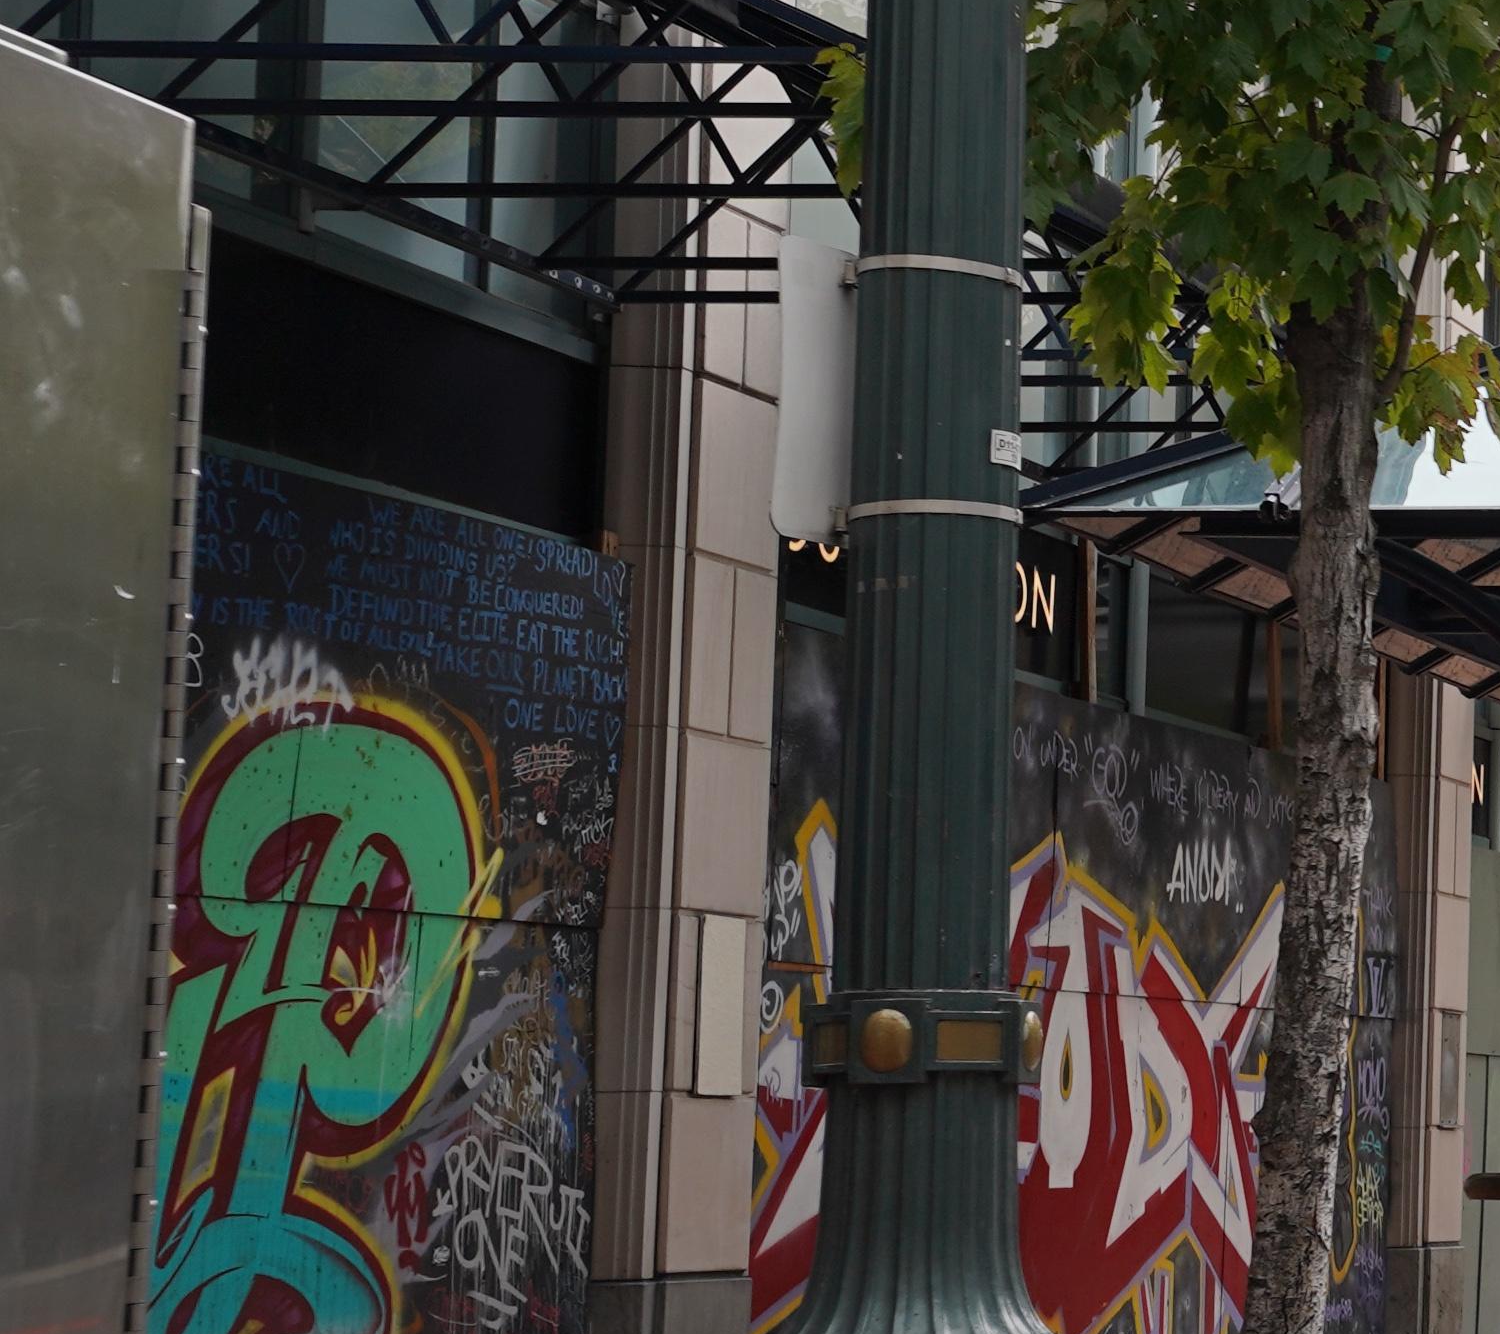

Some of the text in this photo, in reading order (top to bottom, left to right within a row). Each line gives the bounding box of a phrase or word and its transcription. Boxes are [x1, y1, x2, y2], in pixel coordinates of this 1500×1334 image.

[370, 527, 397, 556] IS
[404, 534, 479, 573] DIVIDING
[410, 505, 447, 537] ARE
[456, 518, 488, 548] ALL
[536, 537, 593, 579] SPREAD
[211, 595, 230, 625] IS
[235, 596, 274, 629] THE
[360, 559, 413, 590] MUST
[420, 569, 461, 598] NOT
[466, 574, 492, 605] BE
[494, 582, 584, 620] CONQUERED!
[327, 584, 415, 627] DEFUND
[417, 599, 452, 632] THE
[516, 619, 548, 654] EAT
[552, 625, 580, 658] THE
[585, 627, 624, 665] RICH!
[486, 648, 526, 686] OUR
[504, 697, 600, 741] ONE LOVE
